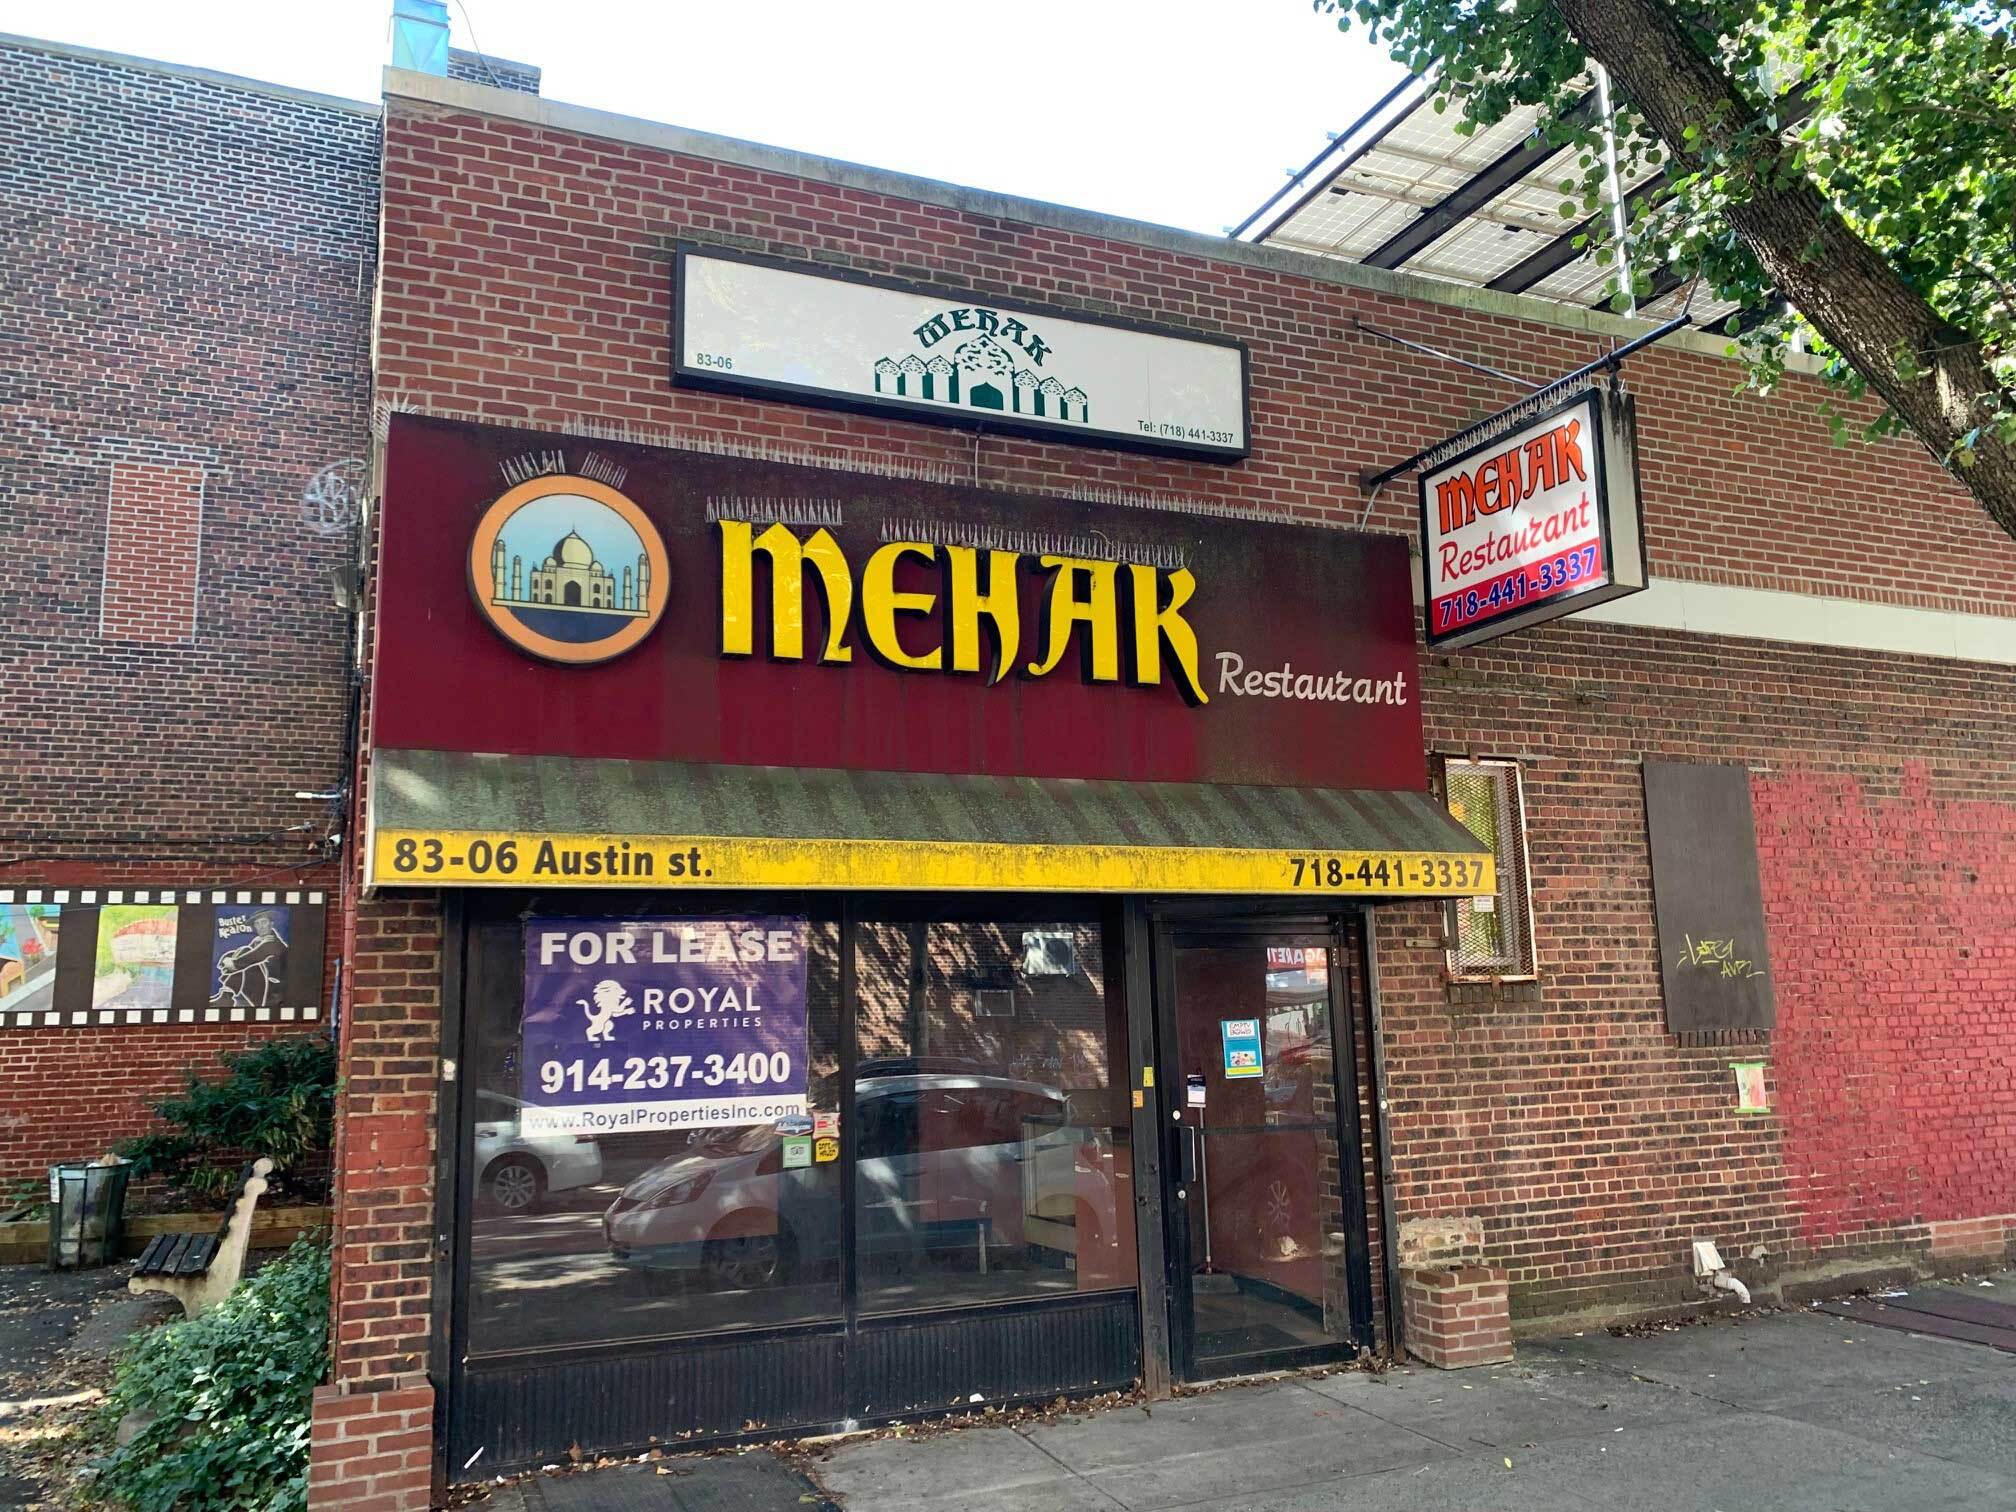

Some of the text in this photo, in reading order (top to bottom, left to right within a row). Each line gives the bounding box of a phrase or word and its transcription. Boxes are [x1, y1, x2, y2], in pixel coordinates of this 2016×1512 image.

[696, 352, 733, 370] 83-06
[1138, 419, 1234, 444] Tel: (718) 441-3337
[1434, 417, 1588, 536] MEHAK
[1438, 491, 1590, 583] Restaurant
[1440, 546, 1596, 627] 718-441-3337
[717, 518, 1408, 707] MEHAK Restaurant
[393, 838, 713, 877] 83-06 Austin st.
[1290, 858, 1484, 888] 718-441-3337
[540, 930, 794, 966] FOR LEASE
[643, 986, 762, 1015] ROYAL
[643, 1016, 762, 1031] PROPERTIES
[540, 1051, 791, 1094] 914-237-3400
[528, 1103, 800, 1130] www.RoyalPropertiesInc.com
